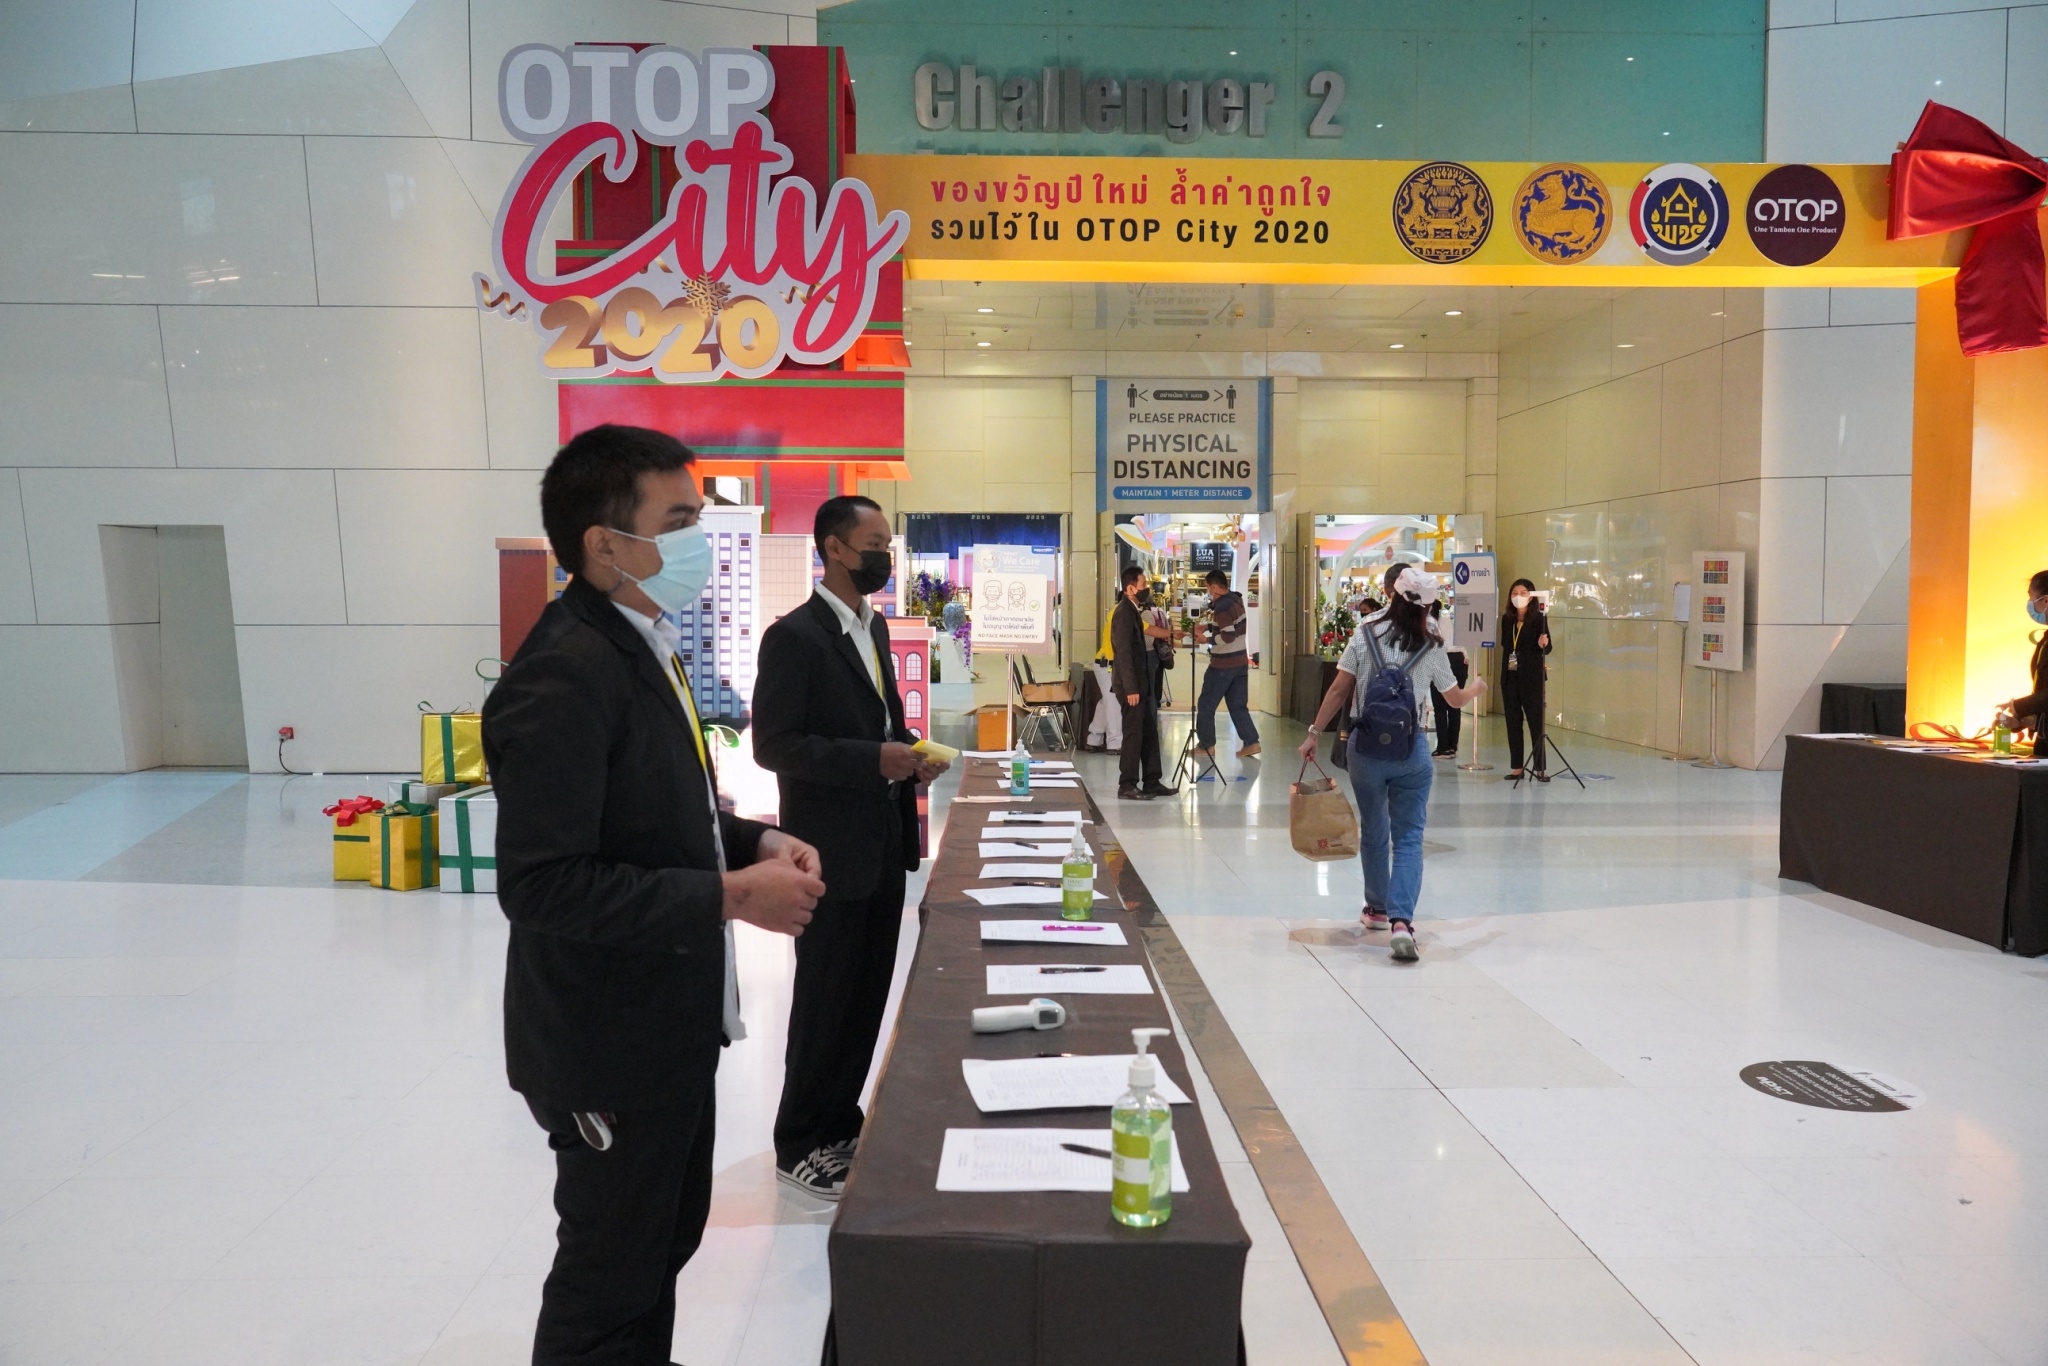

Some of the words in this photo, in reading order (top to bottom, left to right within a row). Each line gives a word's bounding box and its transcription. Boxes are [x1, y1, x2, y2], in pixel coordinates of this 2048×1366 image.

[505, 47, 769, 136] OTOP
[914, 62, 1275, 144] Challenger
[1307, 71, 1346, 139] 2
[1753, 198, 1838, 222] OTOP
[502, 121, 899, 353] City
[931, 211, 1059, 241] รวมไว้ใน
[1076, 217, 1160, 242] OTOP
[1176, 218, 1238, 249] City
[1254, 220, 1329, 244] 2020
[1769, 226, 1796, 234] Tambon
[1811, 226, 1838, 234] Product
[540, 286, 781, 373] 2020
[1129, 413, 1175, 423] PLEASE
[1178, 413, 1236, 423] PRACTICE
[1127, 434, 1238, 453] PHYSICAL
[1114, 460, 1251, 479] DISTANCING
[1122, 489, 1162, 497] MAINTAIN
[1003, 556, 1018, 565] We
[1019, 556, 1041, 566] Care
[1196, 549, 1214, 557] LUA
[1469, 612, 1483, 632] IN
